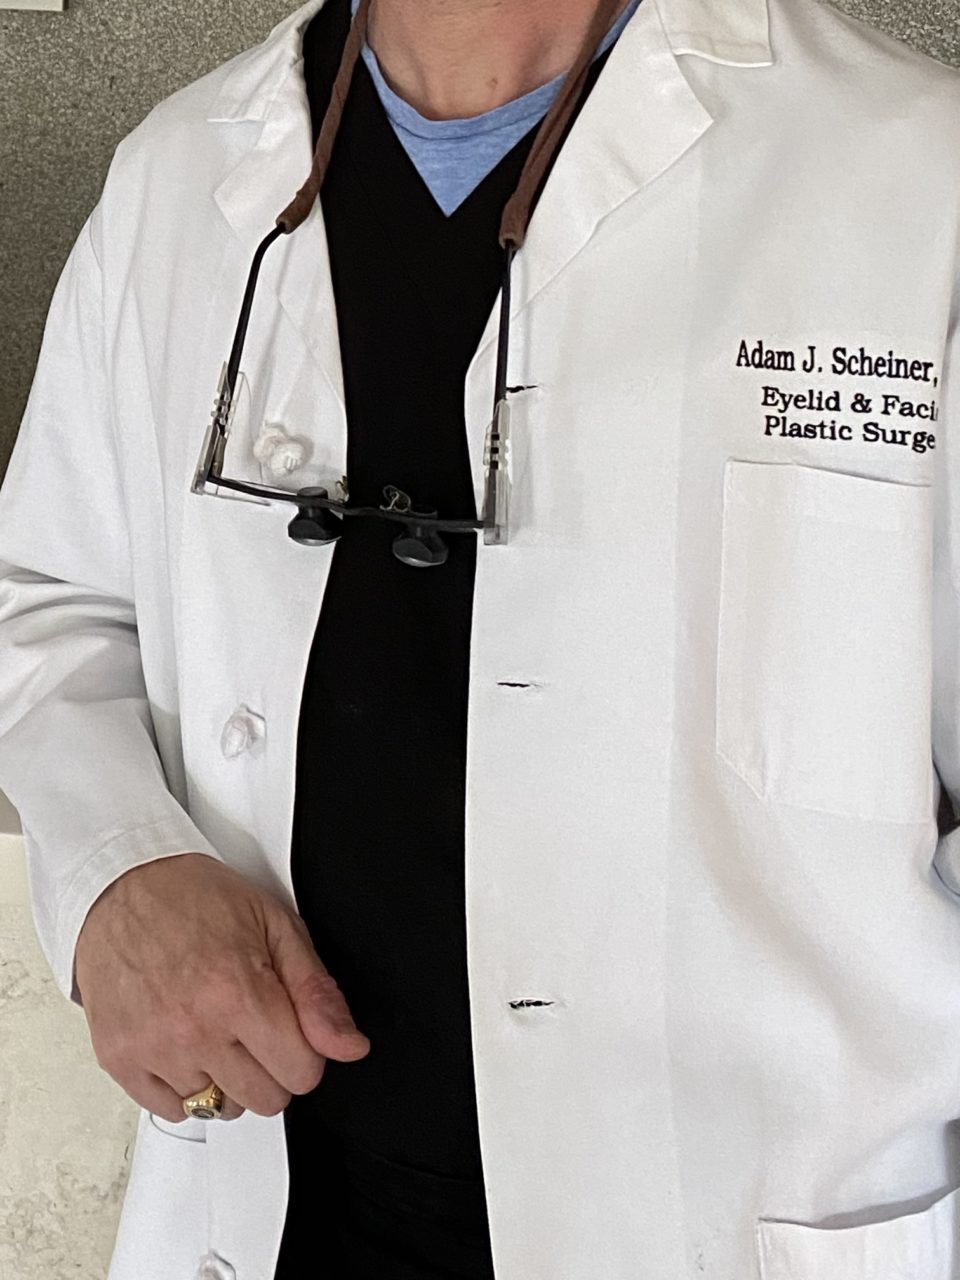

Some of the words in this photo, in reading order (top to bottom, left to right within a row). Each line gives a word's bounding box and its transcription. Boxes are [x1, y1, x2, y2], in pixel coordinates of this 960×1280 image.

[736, 339, 796, 372] Adam
[801, 345, 823, 373] J.
[831, 346, 938, 388] Scheiner,
[761, 386, 841, 413] Eyelid
[850, 392, 873, 414] &
[881, 394, 938, 422] Faci
[764, 415, 853, 441] Plastic
